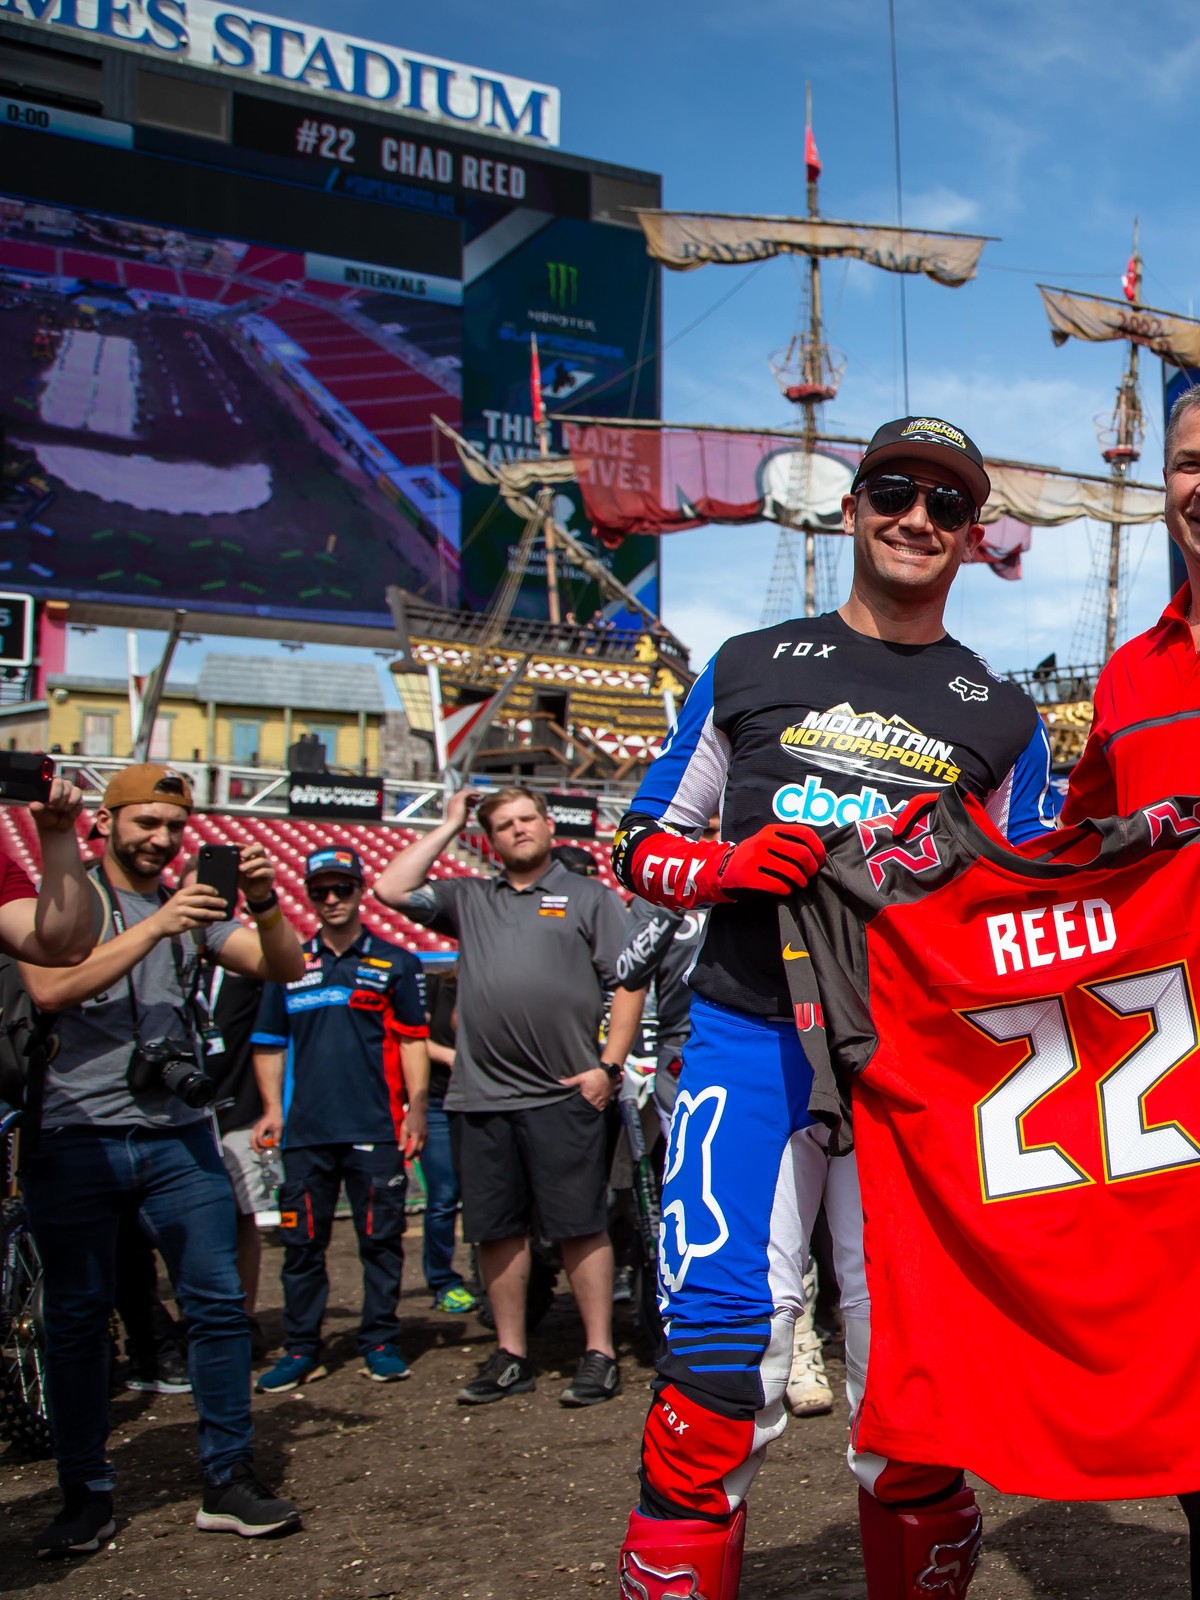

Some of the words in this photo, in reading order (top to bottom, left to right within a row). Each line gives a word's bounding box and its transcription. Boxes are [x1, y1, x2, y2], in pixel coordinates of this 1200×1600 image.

[212, 13, 549, 142] STADIUM
[296, 119, 356, 164] #22
[381, 136, 453, 185] CHAD
[461, 154, 527, 200] REED
[344, 266, 427, 295] INTERVALS
[561, 422, 636, 460] RACE
[907, 419, 965, 441] MOUNTAIN
[773, 642, 837, 659] FOX
[780, 726, 962, 784] MOTORSPORTS
[801, 711, 954, 762] MOUNTAIN
[986, 897, 1117, 976] REED
[663, 1402, 690, 1436] FOX
